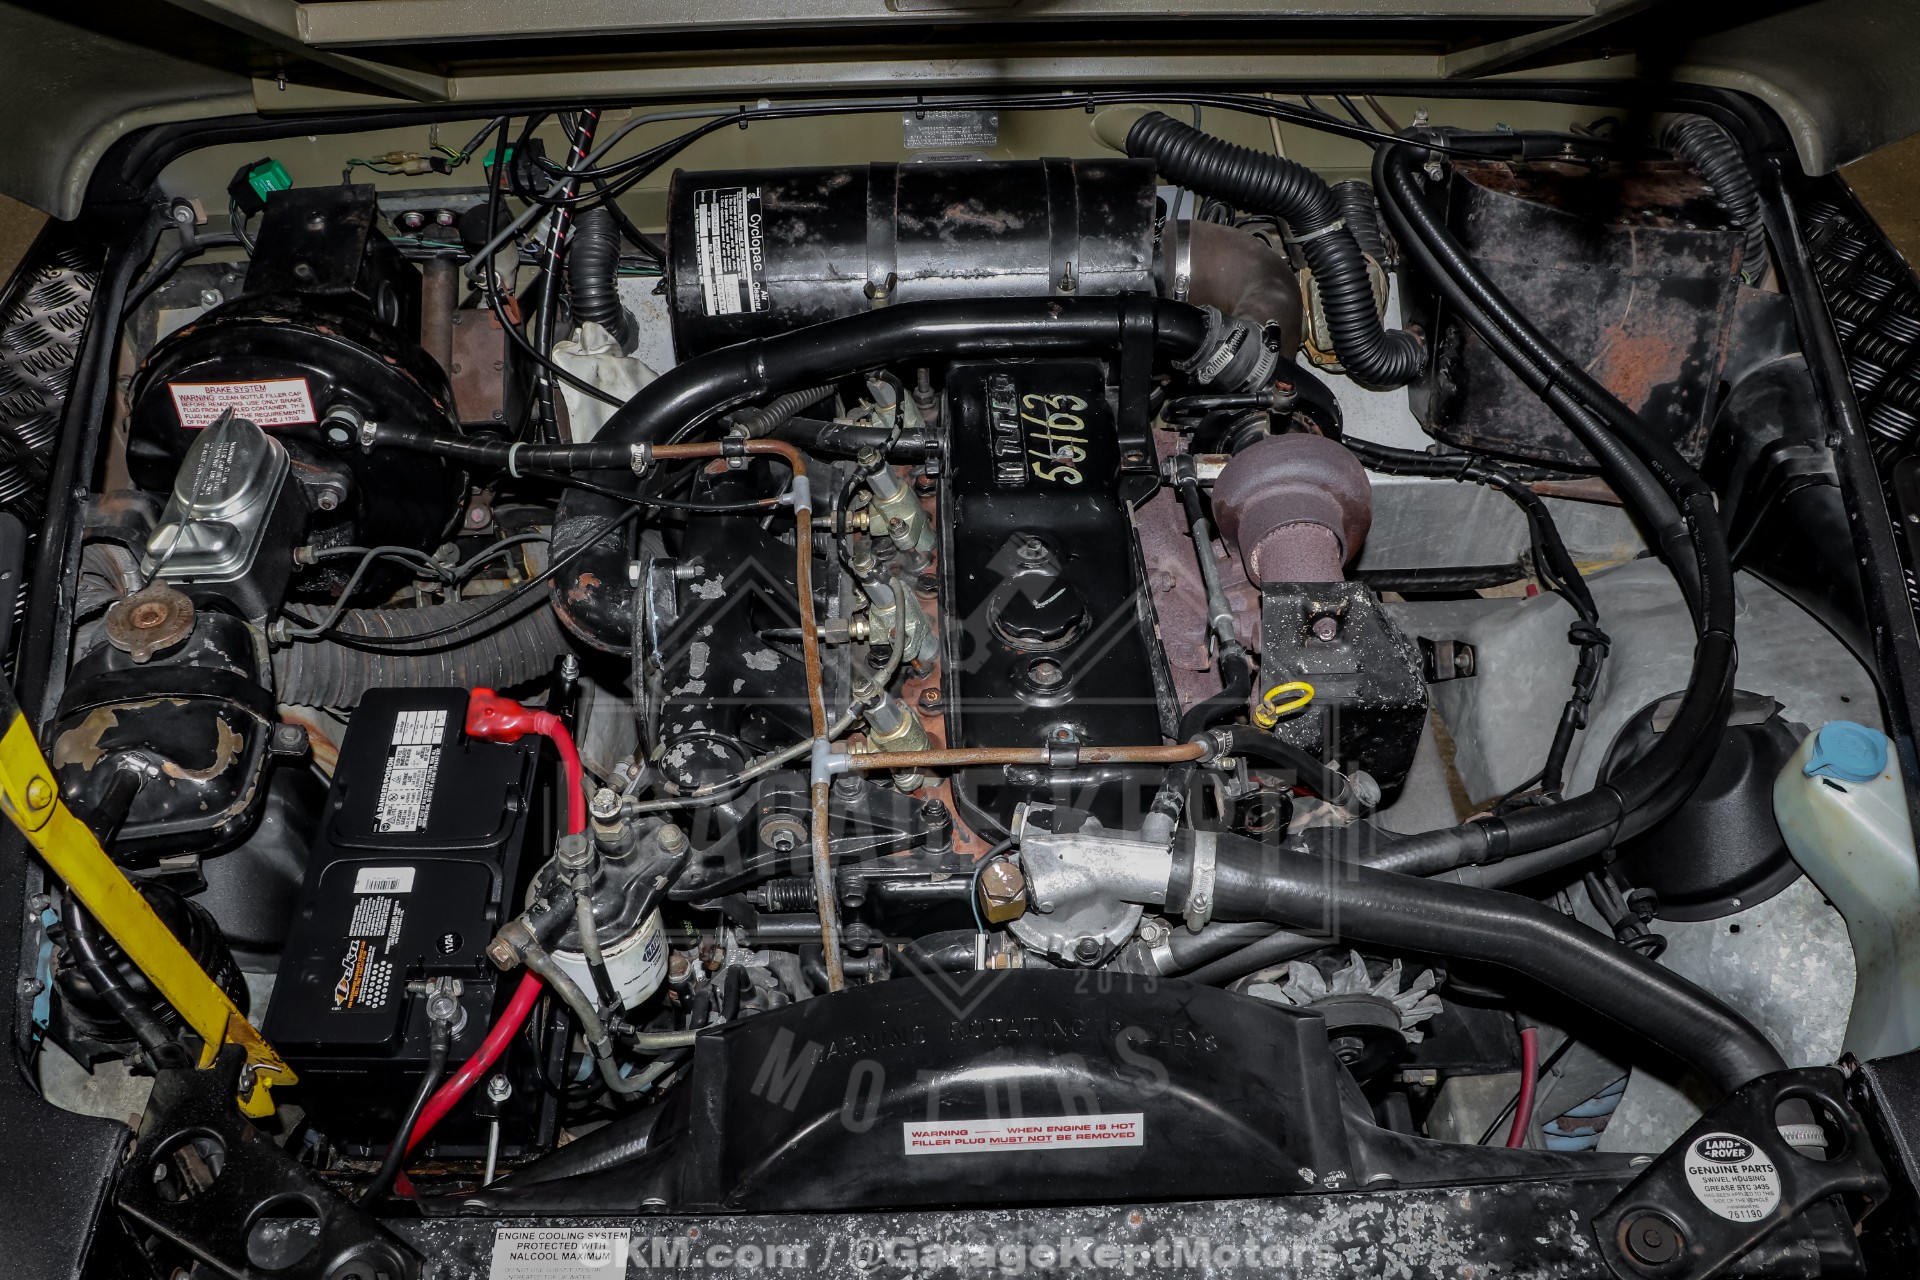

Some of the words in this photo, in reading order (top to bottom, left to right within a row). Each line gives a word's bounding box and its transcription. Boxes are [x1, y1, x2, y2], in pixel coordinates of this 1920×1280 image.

[749, 214, 762, 271] Cyclopac
[753, 282, 761, 309] Cleaner
[445, 934, 453, 953] 11/24
[335, 939, 360, 1006] Deka
[949, 1016, 1088, 1042] ROTATING
[912, 1129, 968, 1138] WARNING
[989, 1136, 1023, 1145] MUST
[1028, 1135, 1052, 1143] NOT
[1712, 1149, 1745, 1157] ROVER
[1689, 1165, 1738, 1175] GENUINE
[1741, 1164, 1774, 1173] PARTS
[1729, 1210, 1762, 1219] 761190
[498, 1232, 535, 1240] ENGINE
[538, 1232, 584, 1240] COOLING
[517, 1242, 578, 1250] PROTECTED
[582, 1242, 606, 1250] WITH
